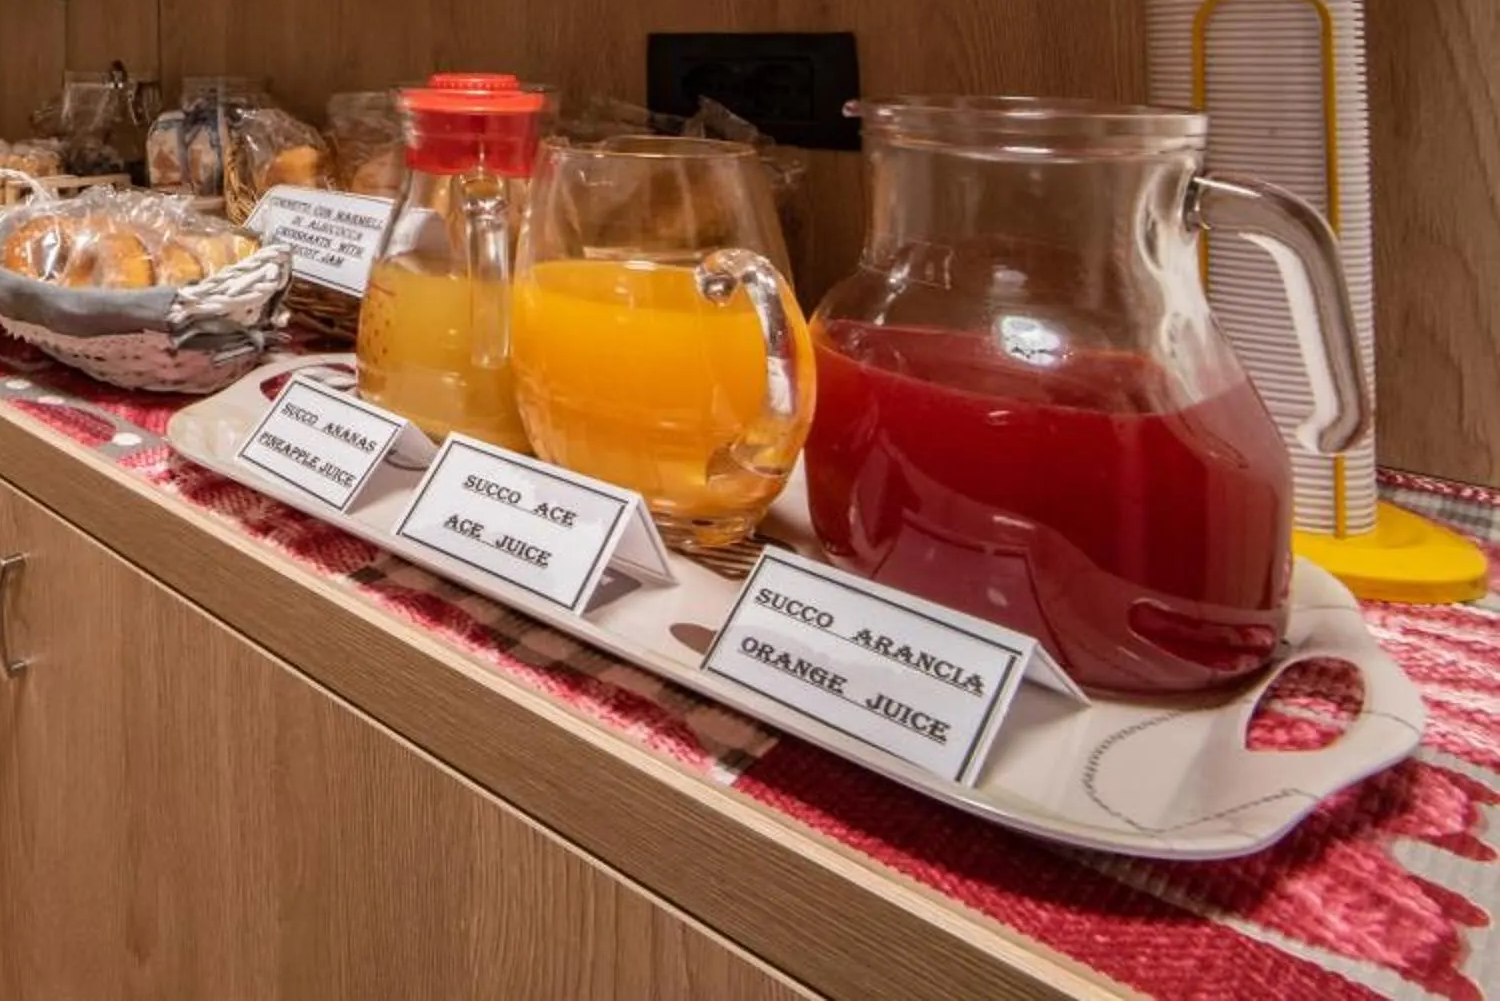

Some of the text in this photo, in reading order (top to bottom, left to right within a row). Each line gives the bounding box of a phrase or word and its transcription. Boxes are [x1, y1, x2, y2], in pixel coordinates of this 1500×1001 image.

[281, 402, 378, 452] SUCCO ANANAS
[257, 431, 357, 487] PINEAPPLE JUICE
[463, 474, 578, 527] SUCCO ACE
[444, 514, 552, 567] ACE JUICE
[755, 587, 986, 696] SUCCO ARANCIA
[739, 636, 951, 743] ORANGE JUICE
